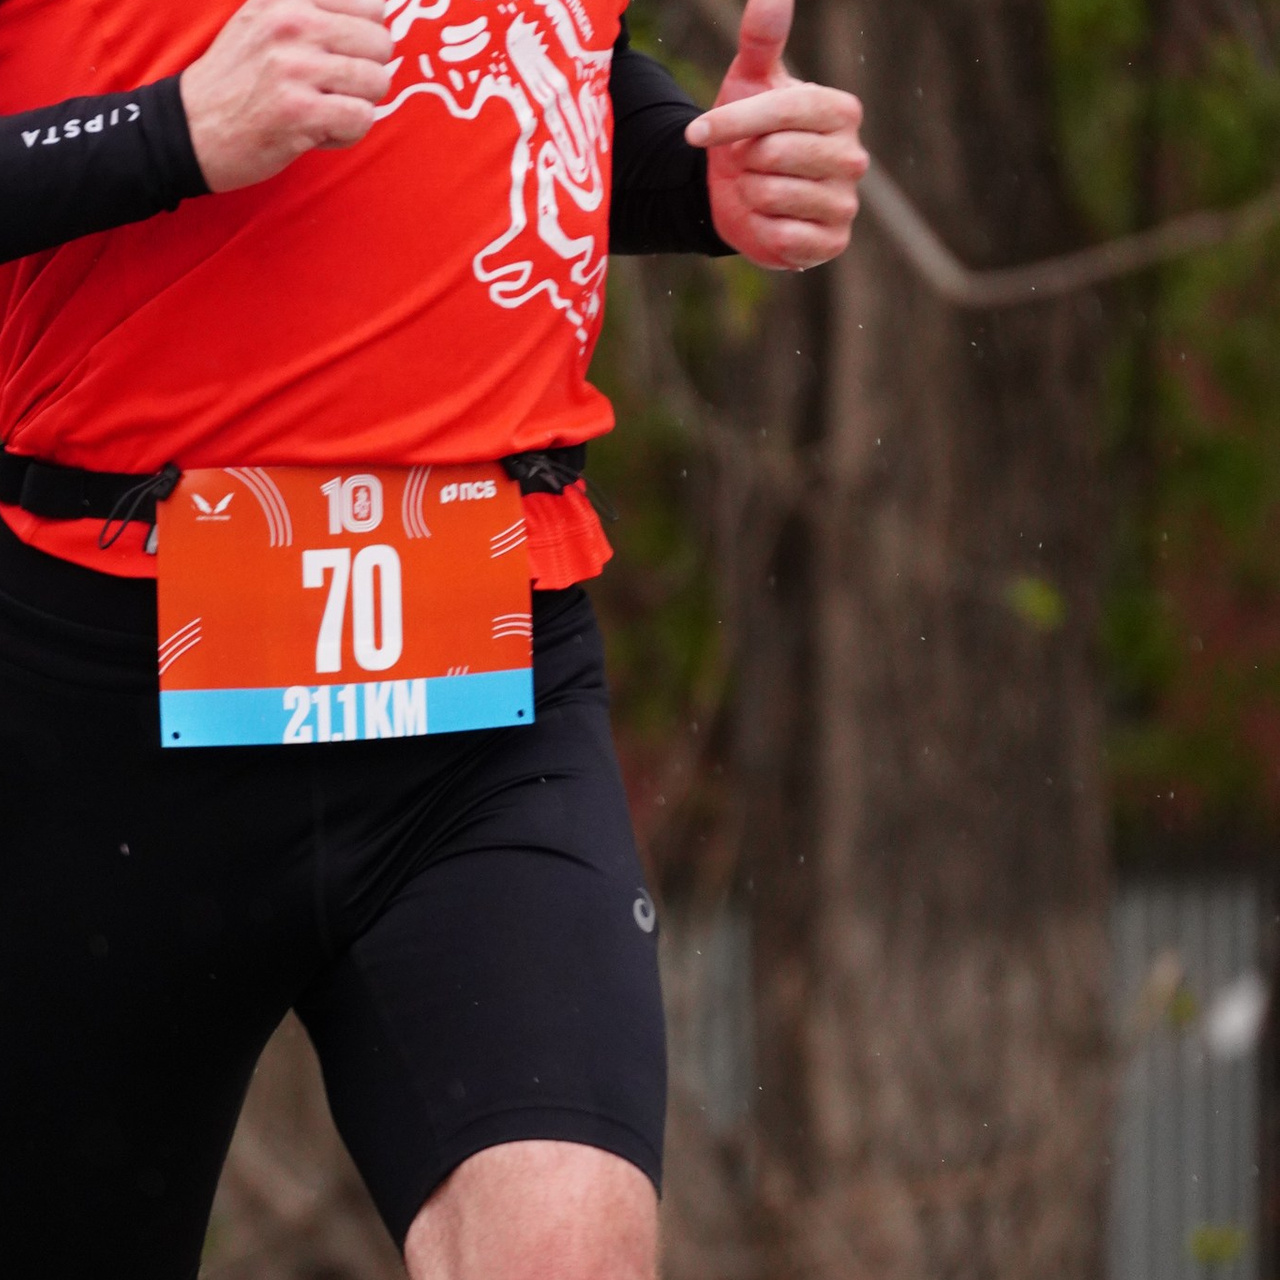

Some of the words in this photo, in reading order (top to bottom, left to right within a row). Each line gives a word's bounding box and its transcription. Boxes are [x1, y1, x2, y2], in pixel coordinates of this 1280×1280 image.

[20, 102, 141, 149] KIPSTA
[320, 474, 384, 536] 10
[302, 544, 404, 674] 70
[282, 682, 358, 745] 21.1
[363, 677, 428, 740] KM
